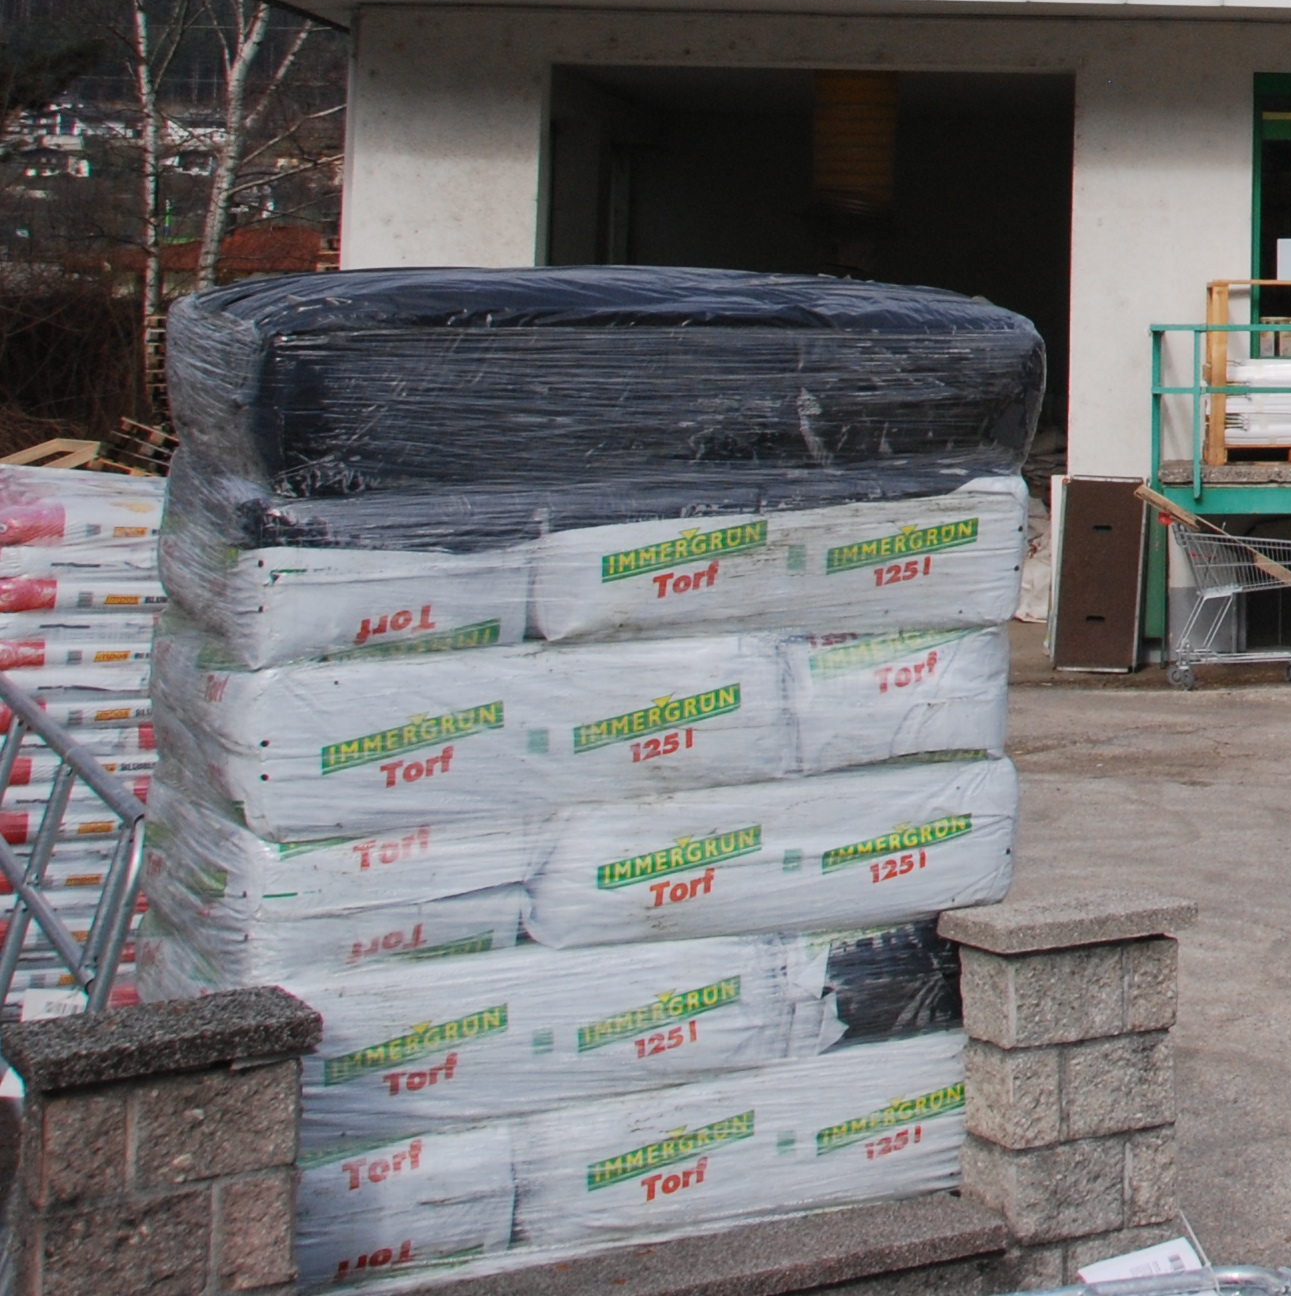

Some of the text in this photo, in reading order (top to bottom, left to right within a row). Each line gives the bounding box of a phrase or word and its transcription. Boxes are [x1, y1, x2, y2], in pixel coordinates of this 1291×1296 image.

[608, 522, 762, 574] IMMERGRÜN
[833, 519, 973, 566] IMMERGRÜN
[653, 560, 719, 598] Torf
[354, 604, 436, 646] Torf
[874, 651, 938, 693] Torf
[329, 704, 497, 765] IMMERGRÜN
[580, 687, 736, 745] IMMERGRÜN
[380, 745, 454, 788] Torf
[605, 829, 755, 884] IMMERGRÜN
[650, 867, 715, 907] Torf
[383, 1052, 458, 1097] Torf
[341, 1138, 423, 1191] Torf
[641, 1156, 708, 1201] Torf
